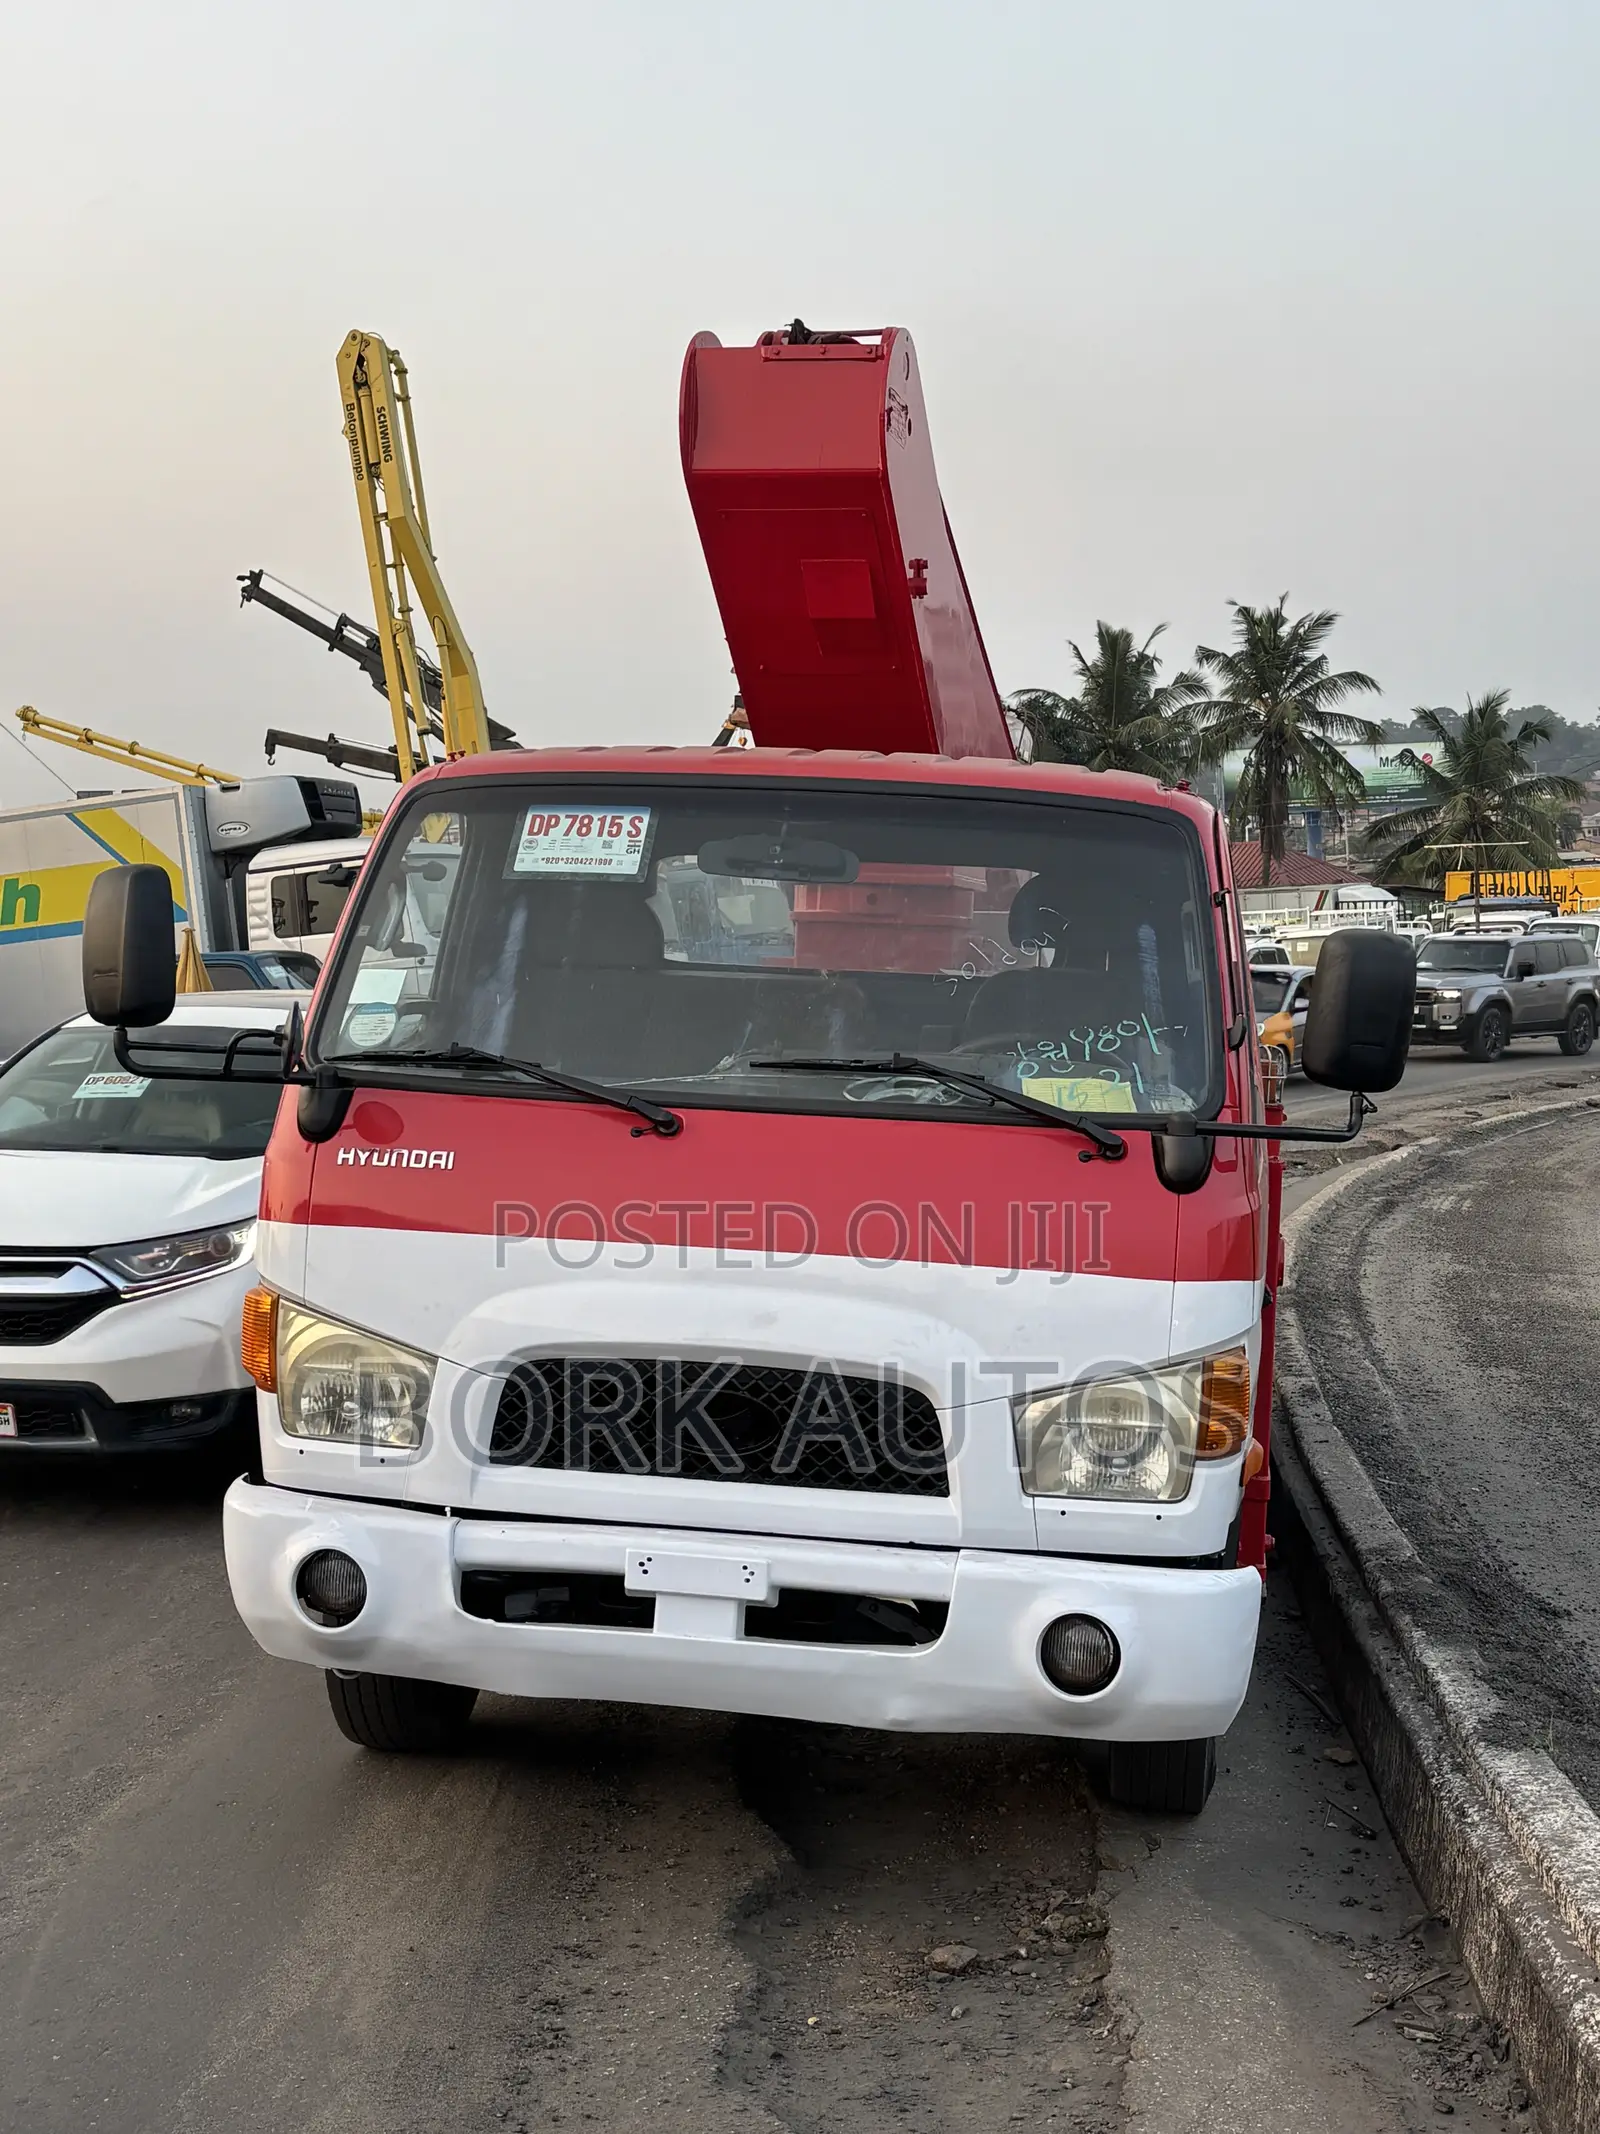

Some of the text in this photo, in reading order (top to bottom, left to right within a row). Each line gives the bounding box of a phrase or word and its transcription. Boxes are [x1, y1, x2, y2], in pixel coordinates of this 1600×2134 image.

[376, 405, 393, 463] SCHWING
[527, 814, 644, 839] DP 7815 S
[337, 1147, 455, 1170] HYUNDAI
